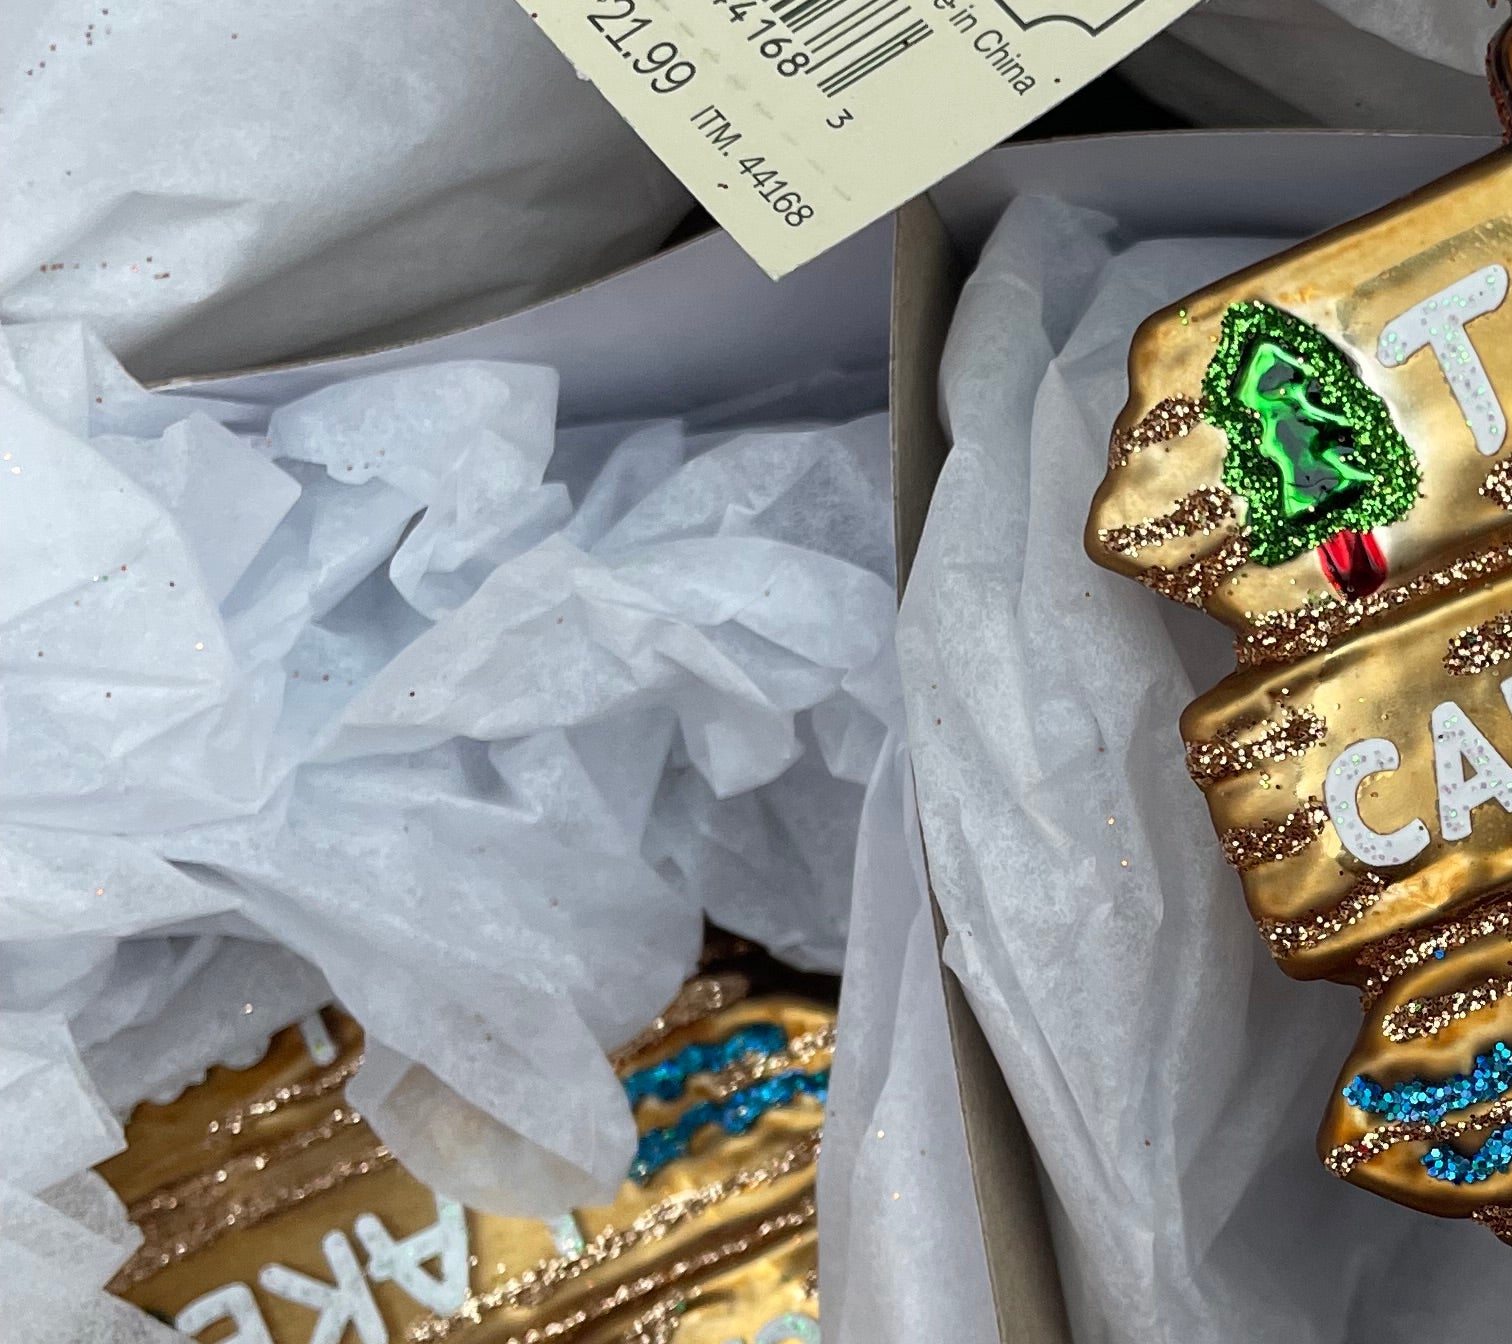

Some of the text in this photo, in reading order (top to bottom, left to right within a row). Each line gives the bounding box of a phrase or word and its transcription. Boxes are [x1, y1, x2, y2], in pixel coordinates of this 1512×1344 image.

[947, 3, 978, 34] in
[972, 28, 1036, 97] China
[824, 106, 855, 130] 3
[688, 103, 743, 157] ITM.
[737, 155, 815, 228] 44168
